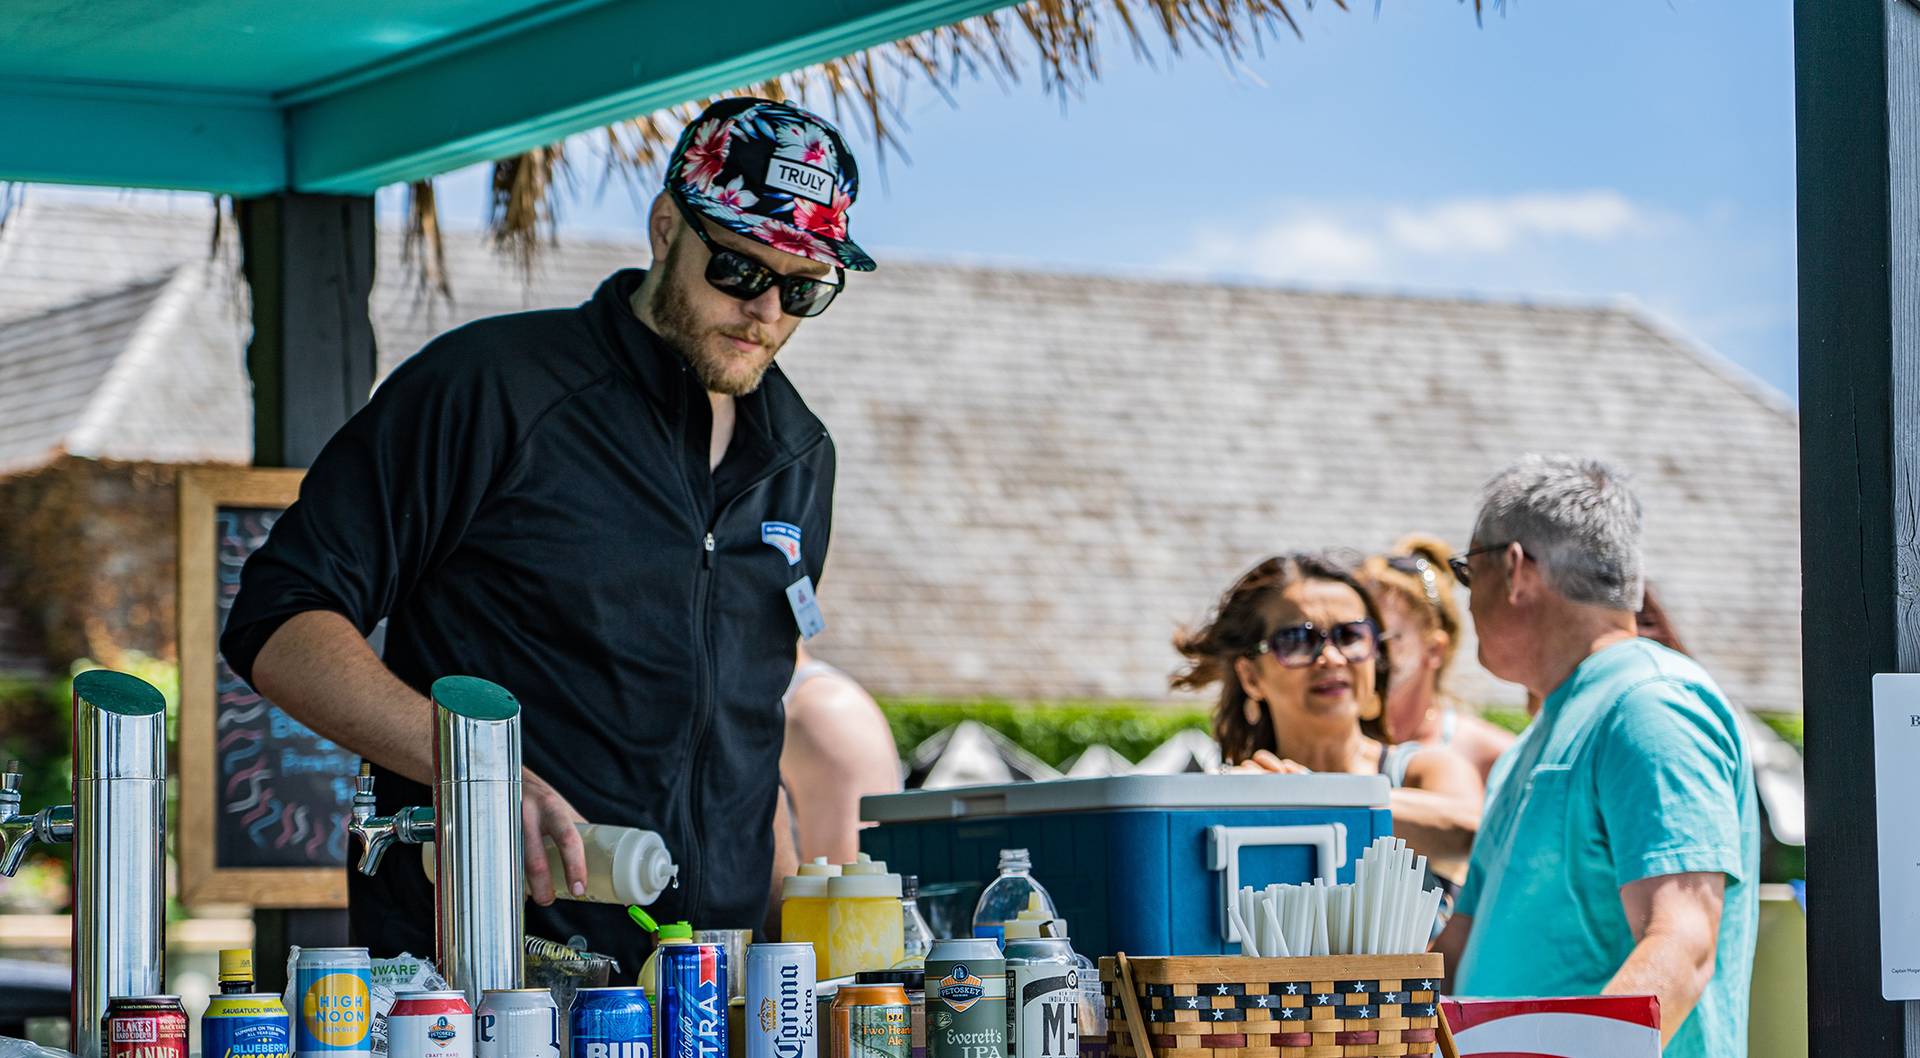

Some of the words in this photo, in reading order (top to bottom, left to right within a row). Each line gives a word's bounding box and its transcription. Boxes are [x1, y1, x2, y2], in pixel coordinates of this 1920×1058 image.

[779, 165, 825, 191] TRULY
[942, 986, 981, 996] PETOSKEY
[319, 995, 363, 1008] HIGH
[315, 1010, 364, 1023] NOON
[774, 964, 804, 1058] Corona
[801, 989, 812, 1038] Extra
[116, 1020, 151, 1032] BLAKE'S
[863, 1025, 884, 1035] Two
[679, 1016, 693, 1058] ichelob
[888, 1036, 903, 1046] Ale
[947, 1028, 1002, 1046] Everett's
[233, 1043, 288, 1053] BLUEBERRY
[587, 1042, 649, 1058] BUD
[961, 1046, 1003, 1058] IPA
